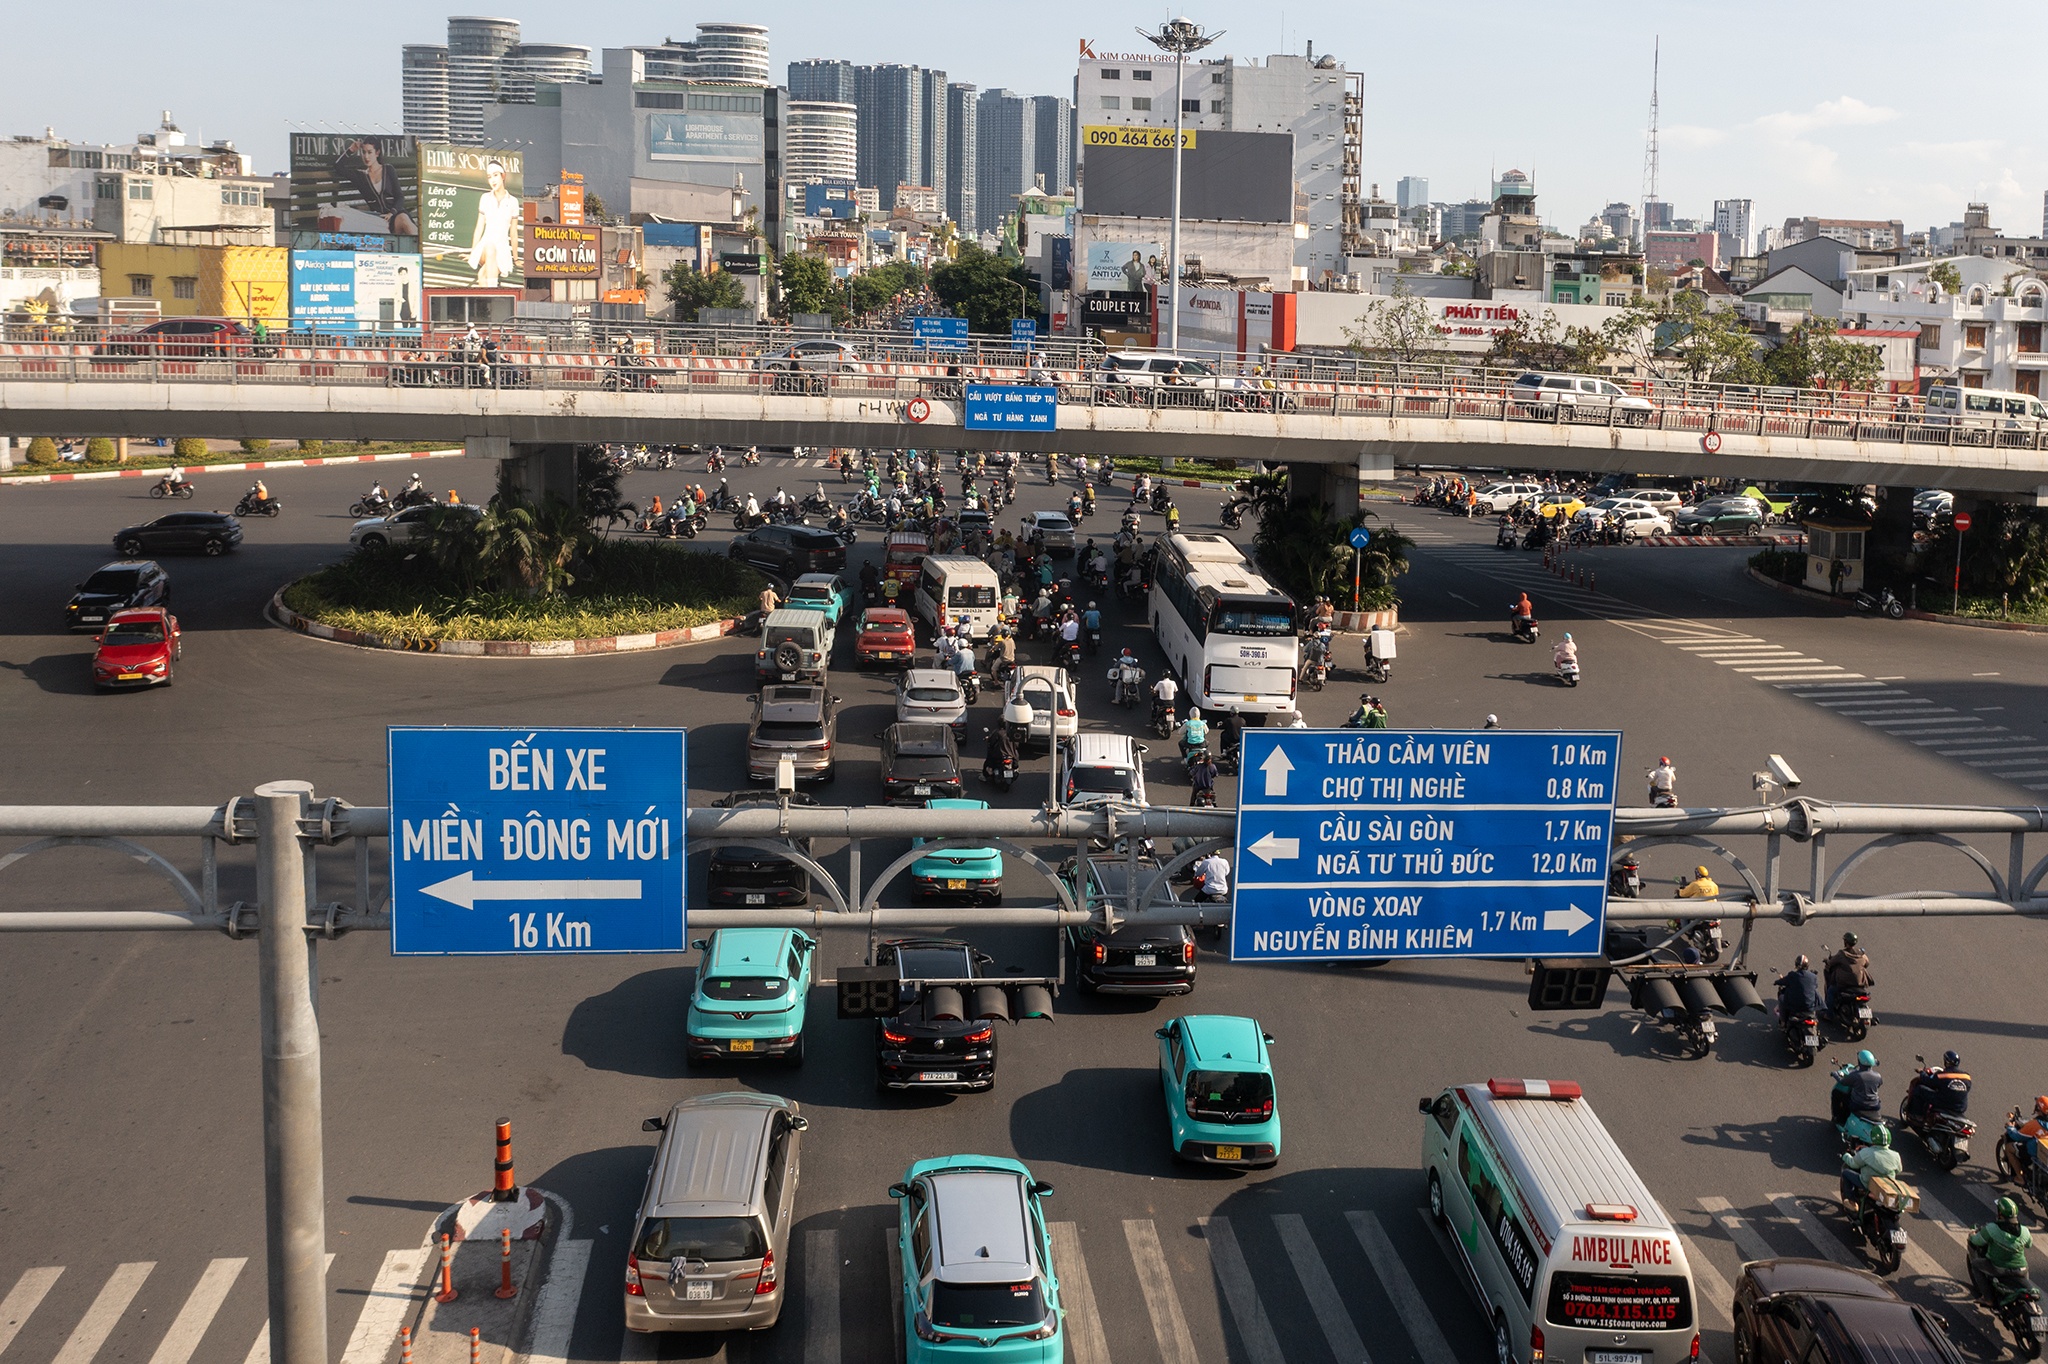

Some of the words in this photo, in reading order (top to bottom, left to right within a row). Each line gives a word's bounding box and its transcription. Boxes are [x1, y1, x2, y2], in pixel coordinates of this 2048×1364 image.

[1100, 52, 1119, 60] KIM
[1121, 53, 1151, 62] OANH
[1153, 54, 1191, 63] GROP
[685, 124, 724, 133] LIGHTHOUSE
[685, 132, 723, 140] APARTMENT
[728, 133, 759, 142] SERVICES
[1091, 131, 1117, 144] 090
[1122, 133, 1148, 146] 464
[1153, 134, 1188, 147] 6699
[428, 186, 444, 195] Lên
[445, 187, 457, 196] đồ
[428, 198, 437, 207] đi
[438, 199, 453, 209] tập
[428, 220, 442, 229] lên
[443, 220, 455, 229] đồ
[428, 232, 437, 240] đi
[438, 232, 454, 242] tiệc
[534, 227, 556, 239] Phúc
[556, 228, 568, 242] Lộc
[819, 230, 839, 238] SUGAR
[534, 245, 567, 263] CƠM
[570, 241, 596, 263] TẤM
[304, 260, 325, 270] Airdog
[1090, 300, 1126, 312] COUPLE
[1128, 302, 1140, 313] TX
[1196, 299, 1222, 310] HONDA
[1446, 303, 1482, 319] PHÁT
[1484, 304, 1518, 320] TIẾN
[984, 392, 1002, 403] VƯỢT
[1025, 392, 1042, 403] THÉP
[1044, 395, 1055, 405] TẠI
[974, 412, 988, 421] NGÃ
[993, 412, 1003, 421] TƯ
[1006, 412, 1024, 422] HÀNG
[1029, 414, 1047, 423] XANH
[1325, 737, 1381, 764] THẢO
[1388, 735, 1434, 764] CẦM
[1442, 740, 1490, 765] VIÊN
[1551, 744, 1575, 766] 1,0
[1579, 744, 1607, 765] Km
[489, 733, 554, 790] BẾN
[565, 749, 606, 790] XE
[1322, 776, 1364, 801] CHỢ
[1370, 778, 1403, 801] THỊ
[1410, 772, 1466, 799] NGHÈ
[1547, 778, 1572, 800] 0,8
[1576, 778, 1604, 799] Km
[402, 803, 483, 861] MIỀN
[500, 810, 591, 861] ĐÔNG
[607, 805, 669, 860] MỚI
[1319, 811, 1361, 842] CẦU
[1368, 815, 1402, 841] SÀI
[1410, 814, 1454, 841] GÒN
[1545, 820, 1569, 842] 1,7
[1573, 820, 1601, 841] Km
[1317, 850, 1360, 875] NGÃ
[1367, 853, 1396, 875] TƯ
[1402, 848, 1444, 875] THỦ
[1451, 848, 1494, 874] ĐỨC
[1532, 853, 1566, 875] 12,0
[1569, 853, 1597, 873] Km
[1308, 891, 1366, 918] VÒNG
[1372, 896, 1423, 917] XOAY
[1481, 911, 1505, 933] 1,7
[1510, 911, 1537, 931] Km
[509, 912, 539, 948] 16
[547, 912, 591, 947] Km
[1254, 922, 1341, 951] NGUYỄN
[1348, 923, 1398, 949] BỈNH
[1405, 924, 1473, 949] KHIÊM
[1500, 1215, 1534, 1289] 0704.115.115
[1572, 1236, 1672, 1265] AMBULANCE
[1563, 1292, 1570, 1300] SỐ
[1669, 1296, 1680, 1304] HCM
[1570, 1285, 1592, 1293] TRUNG
[1593, 1285, 1607, 1293] TÂM
[1609, 1286, 1622, 1294] CẤP
[1637, 1286, 1653, 1295] TOÀN
[1655, 1286, 1672, 1296] QUỐC
[1565, 1302, 1676, 1319] 0704.115.115
[1574, 1317, 1667, 1329] www.115toanquoc.com
